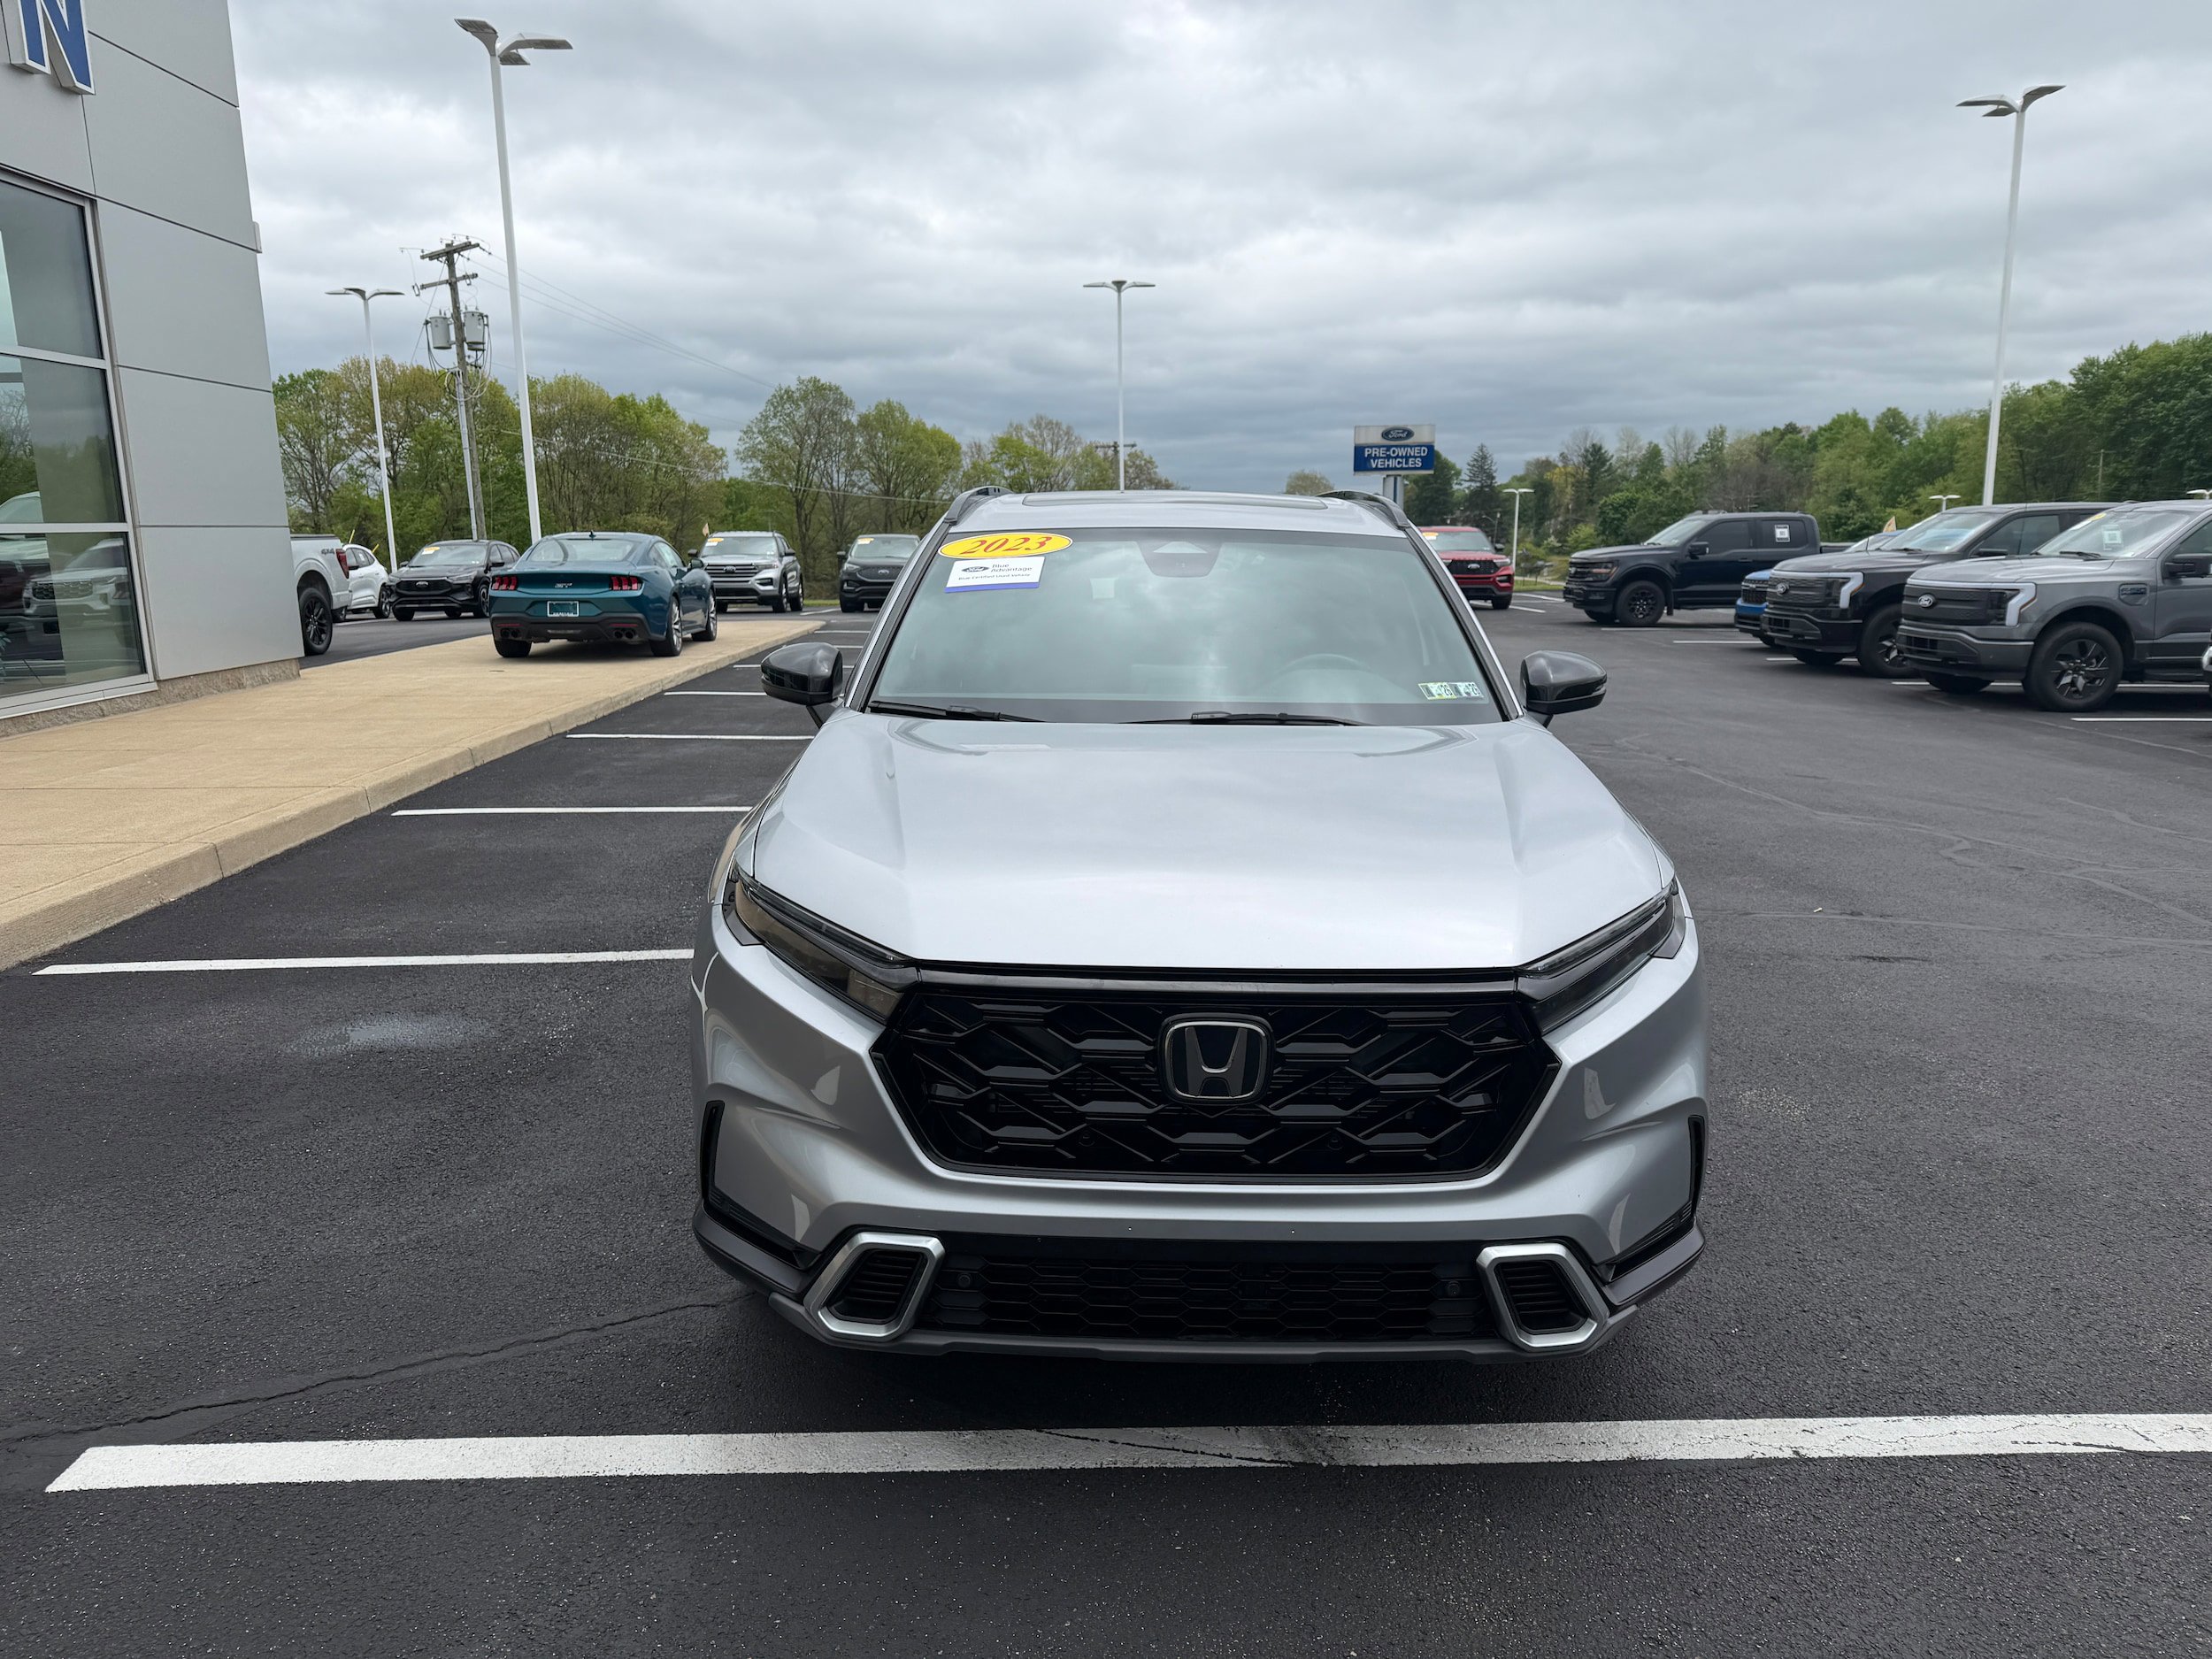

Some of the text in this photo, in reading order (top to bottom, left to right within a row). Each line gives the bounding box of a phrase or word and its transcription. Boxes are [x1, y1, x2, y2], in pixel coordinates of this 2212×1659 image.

[18, 0, 96, 95] N
[1364, 447, 1428, 457] PRE-OWNED
[1371, 457, 1422, 468] VEHICLES
[959, 536, 1052, 555] 2023
